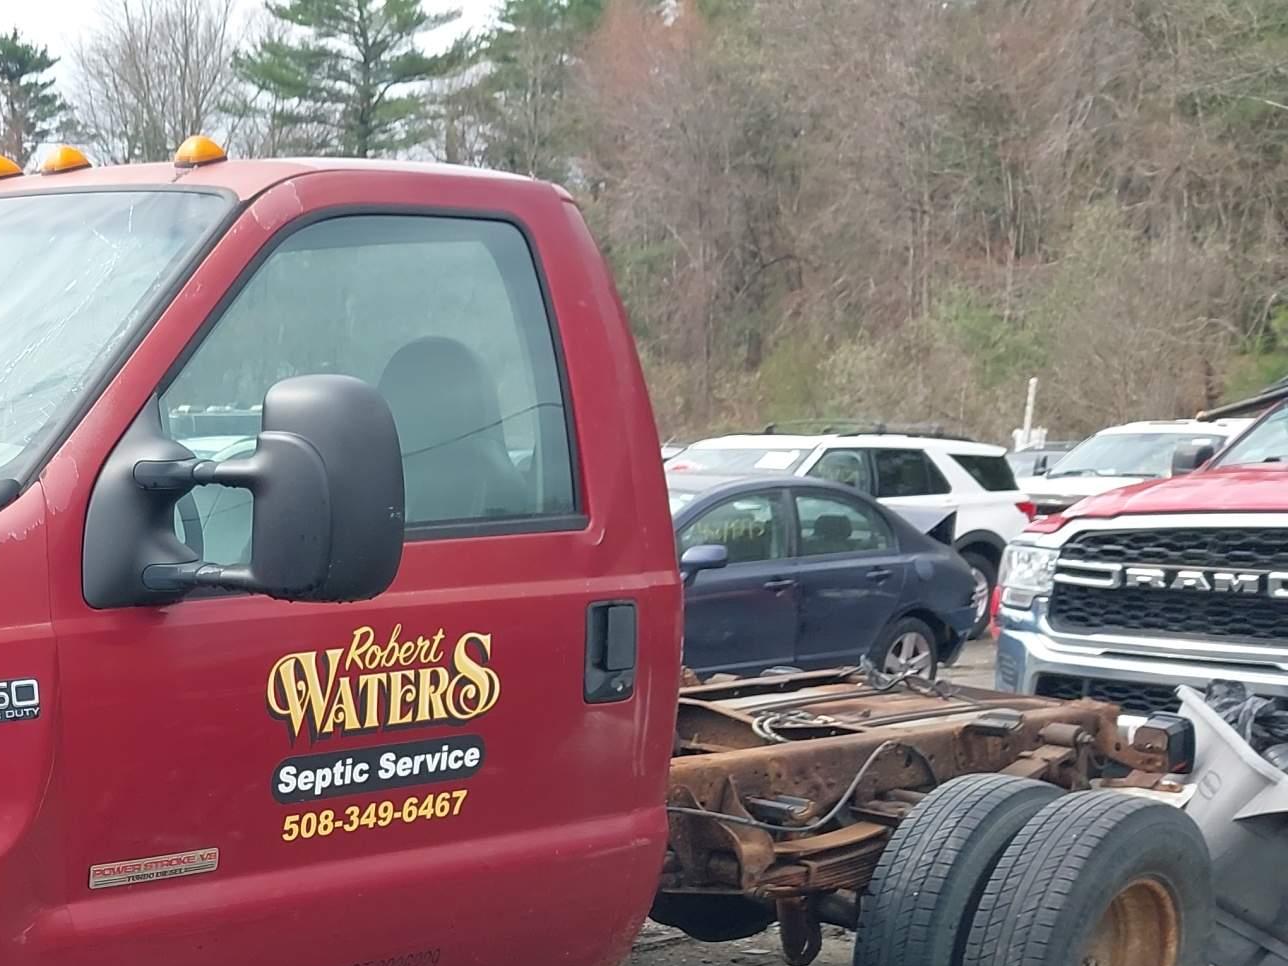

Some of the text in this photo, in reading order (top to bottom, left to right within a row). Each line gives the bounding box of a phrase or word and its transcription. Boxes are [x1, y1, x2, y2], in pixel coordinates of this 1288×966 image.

[1125, 567, 1260, 593] RAM
[345, 623, 446, 671] Robert
[266, 632, 501, 741] WATERS
[6, 707, 41, 719] DUTY
[278, 745, 480, 795] Septic Service
[281, 790, 468, 841] 508-349-6467
[93, 864, 142, 877] POWER
[143, 855, 195, 871] STROKE
